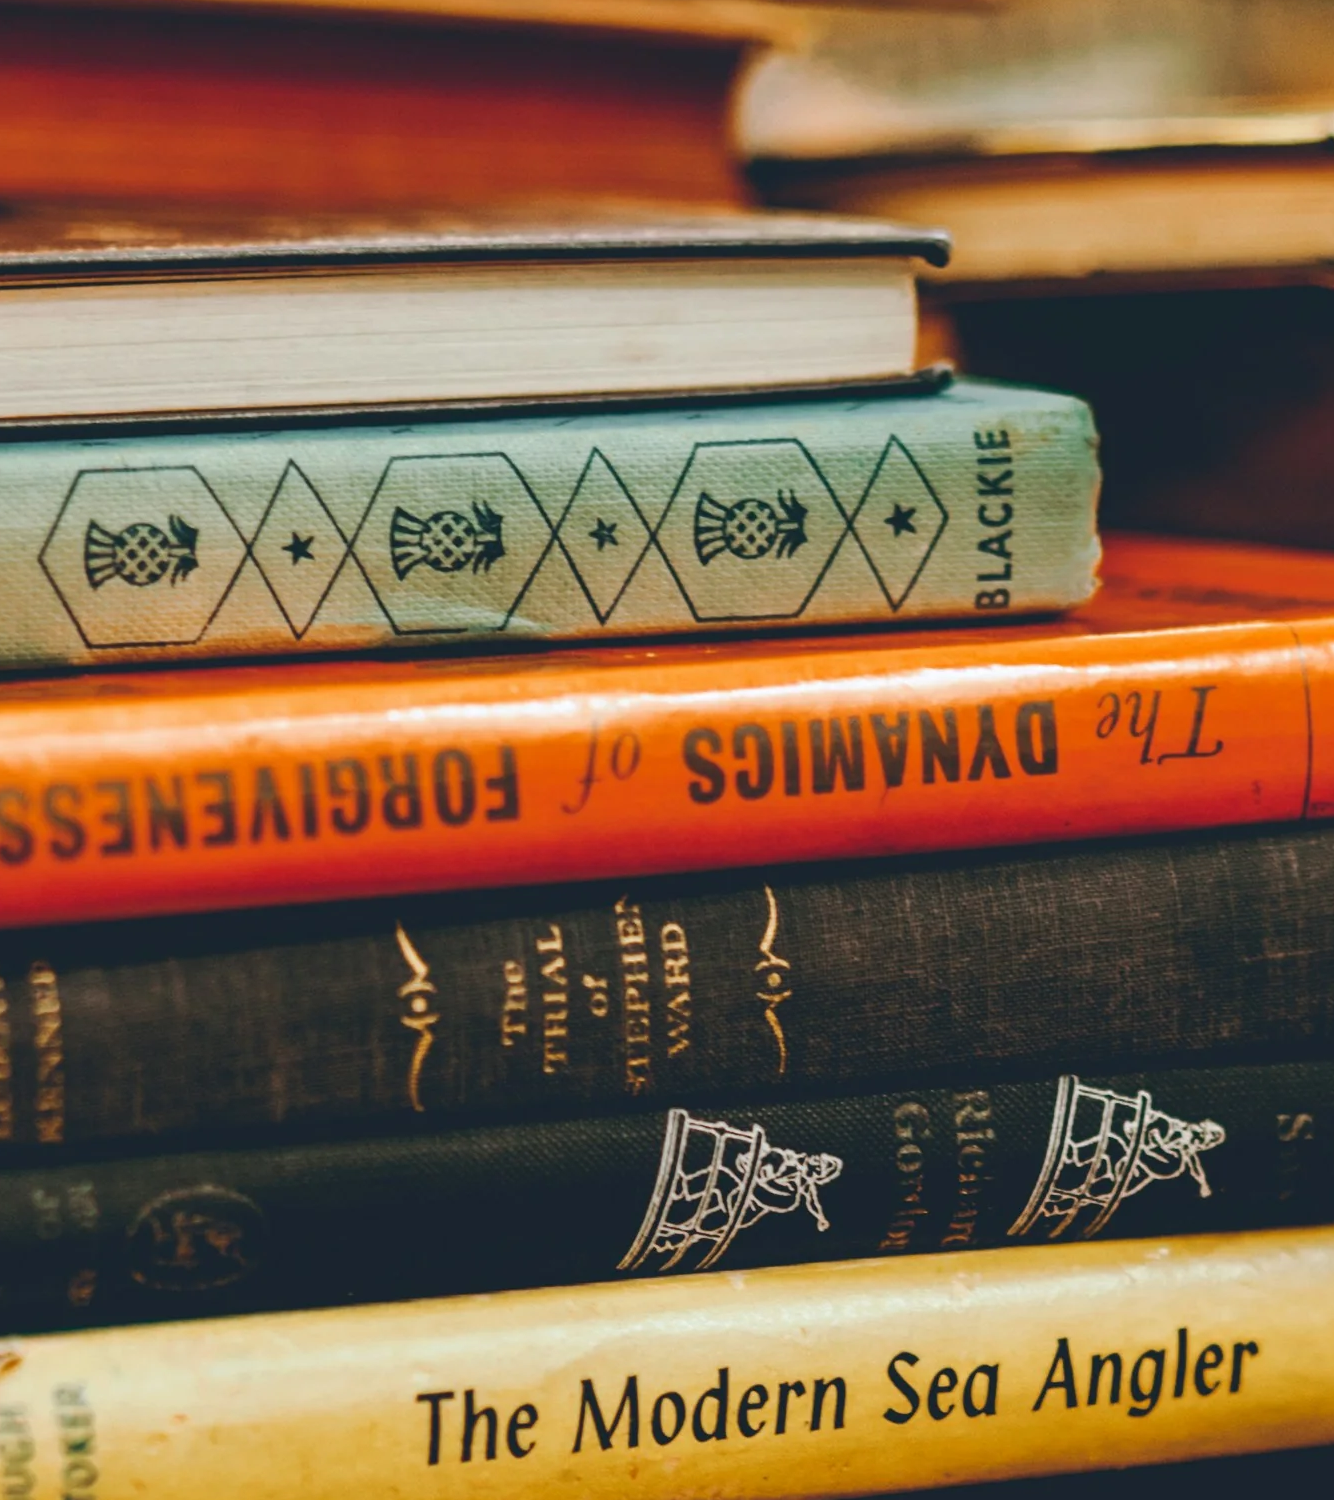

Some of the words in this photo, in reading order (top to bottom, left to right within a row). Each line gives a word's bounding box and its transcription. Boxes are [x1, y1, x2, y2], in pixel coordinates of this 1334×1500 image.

[974, 428, 1011, 610] BLACKIE
[561, 712, 642, 814] of
[684, 700, 1058, 804] DYNAMICS
[1095, 684, 1224, 765] The
[500, 958, 528, 1046] The
[535, 923, 569, 1074] TRIAL
[581, 973, 609, 1018] of
[659, 921, 693, 1058] WARD
[415, 1387, 538, 1466] The
[572, 1368, 847, 1454] Modern
[883, 1351, 1000, 1425] Sea
[1032, 1328, 1261, 1417] Angler
